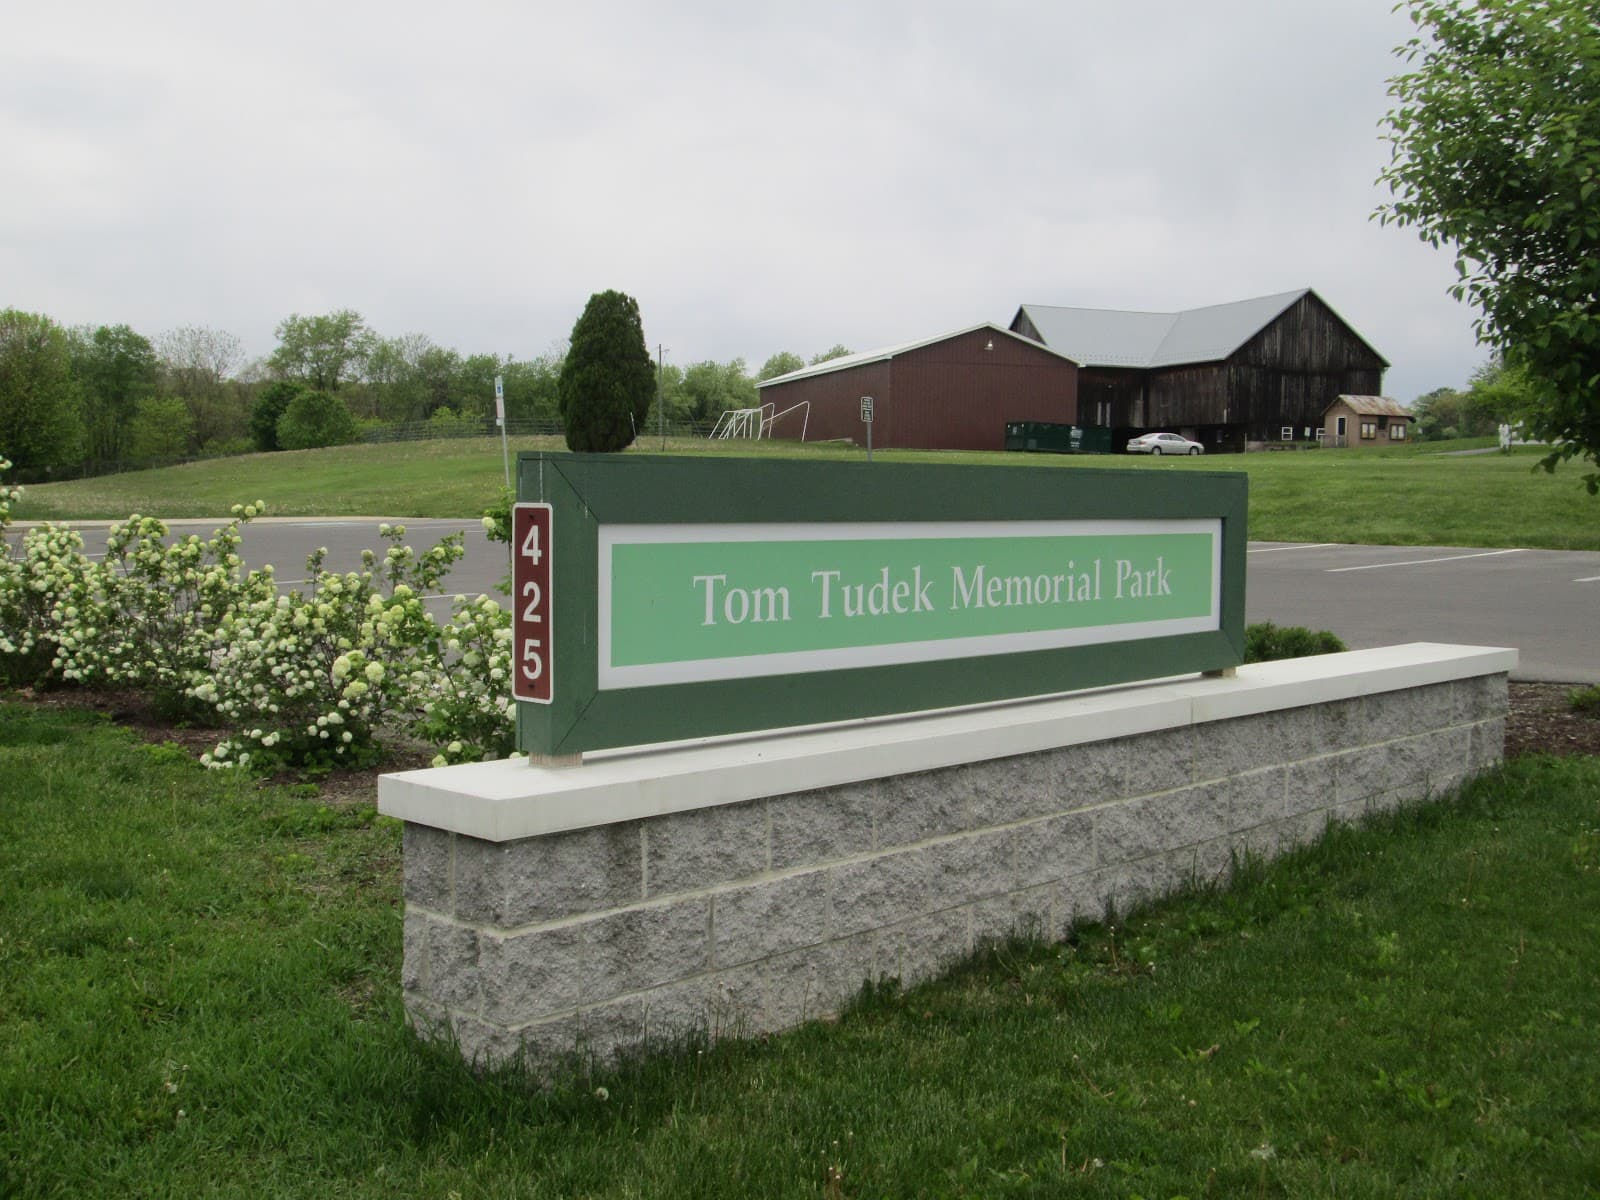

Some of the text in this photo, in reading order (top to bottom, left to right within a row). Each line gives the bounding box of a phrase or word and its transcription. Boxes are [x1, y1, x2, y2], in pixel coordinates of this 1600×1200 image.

[693, 556, 1172, 625] Tom Tudek Memorial Park
